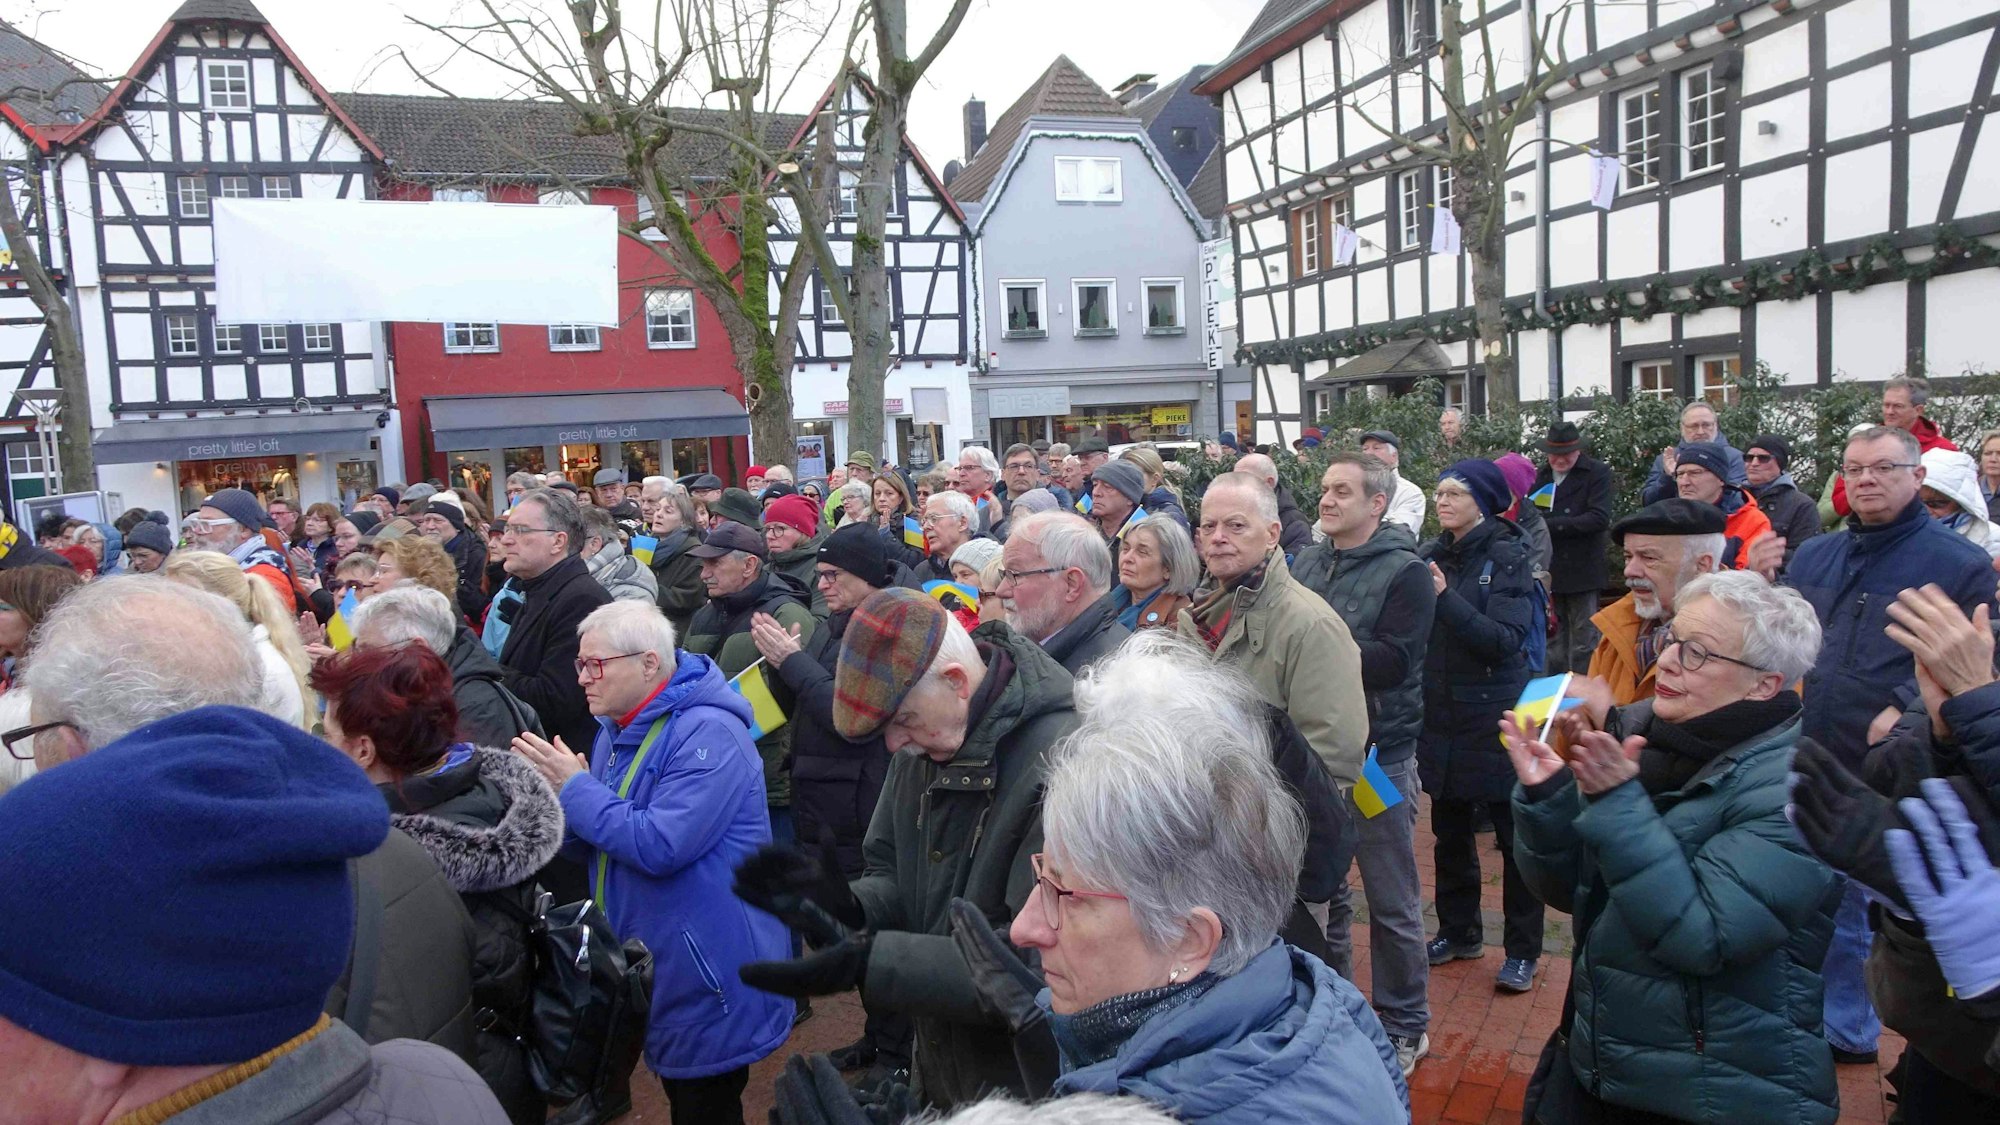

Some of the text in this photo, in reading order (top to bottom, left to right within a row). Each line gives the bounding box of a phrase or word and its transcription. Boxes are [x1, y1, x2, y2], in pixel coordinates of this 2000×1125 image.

[1205, 262, 1217, 368] PIEKE
[992, 393, 1065, 410] PIEKE
[1166, 414, 1186, 422] PIEKE
[559, 424, 638, 444] pretty little loft
[188, 437, 280, 459] pretty little loft
